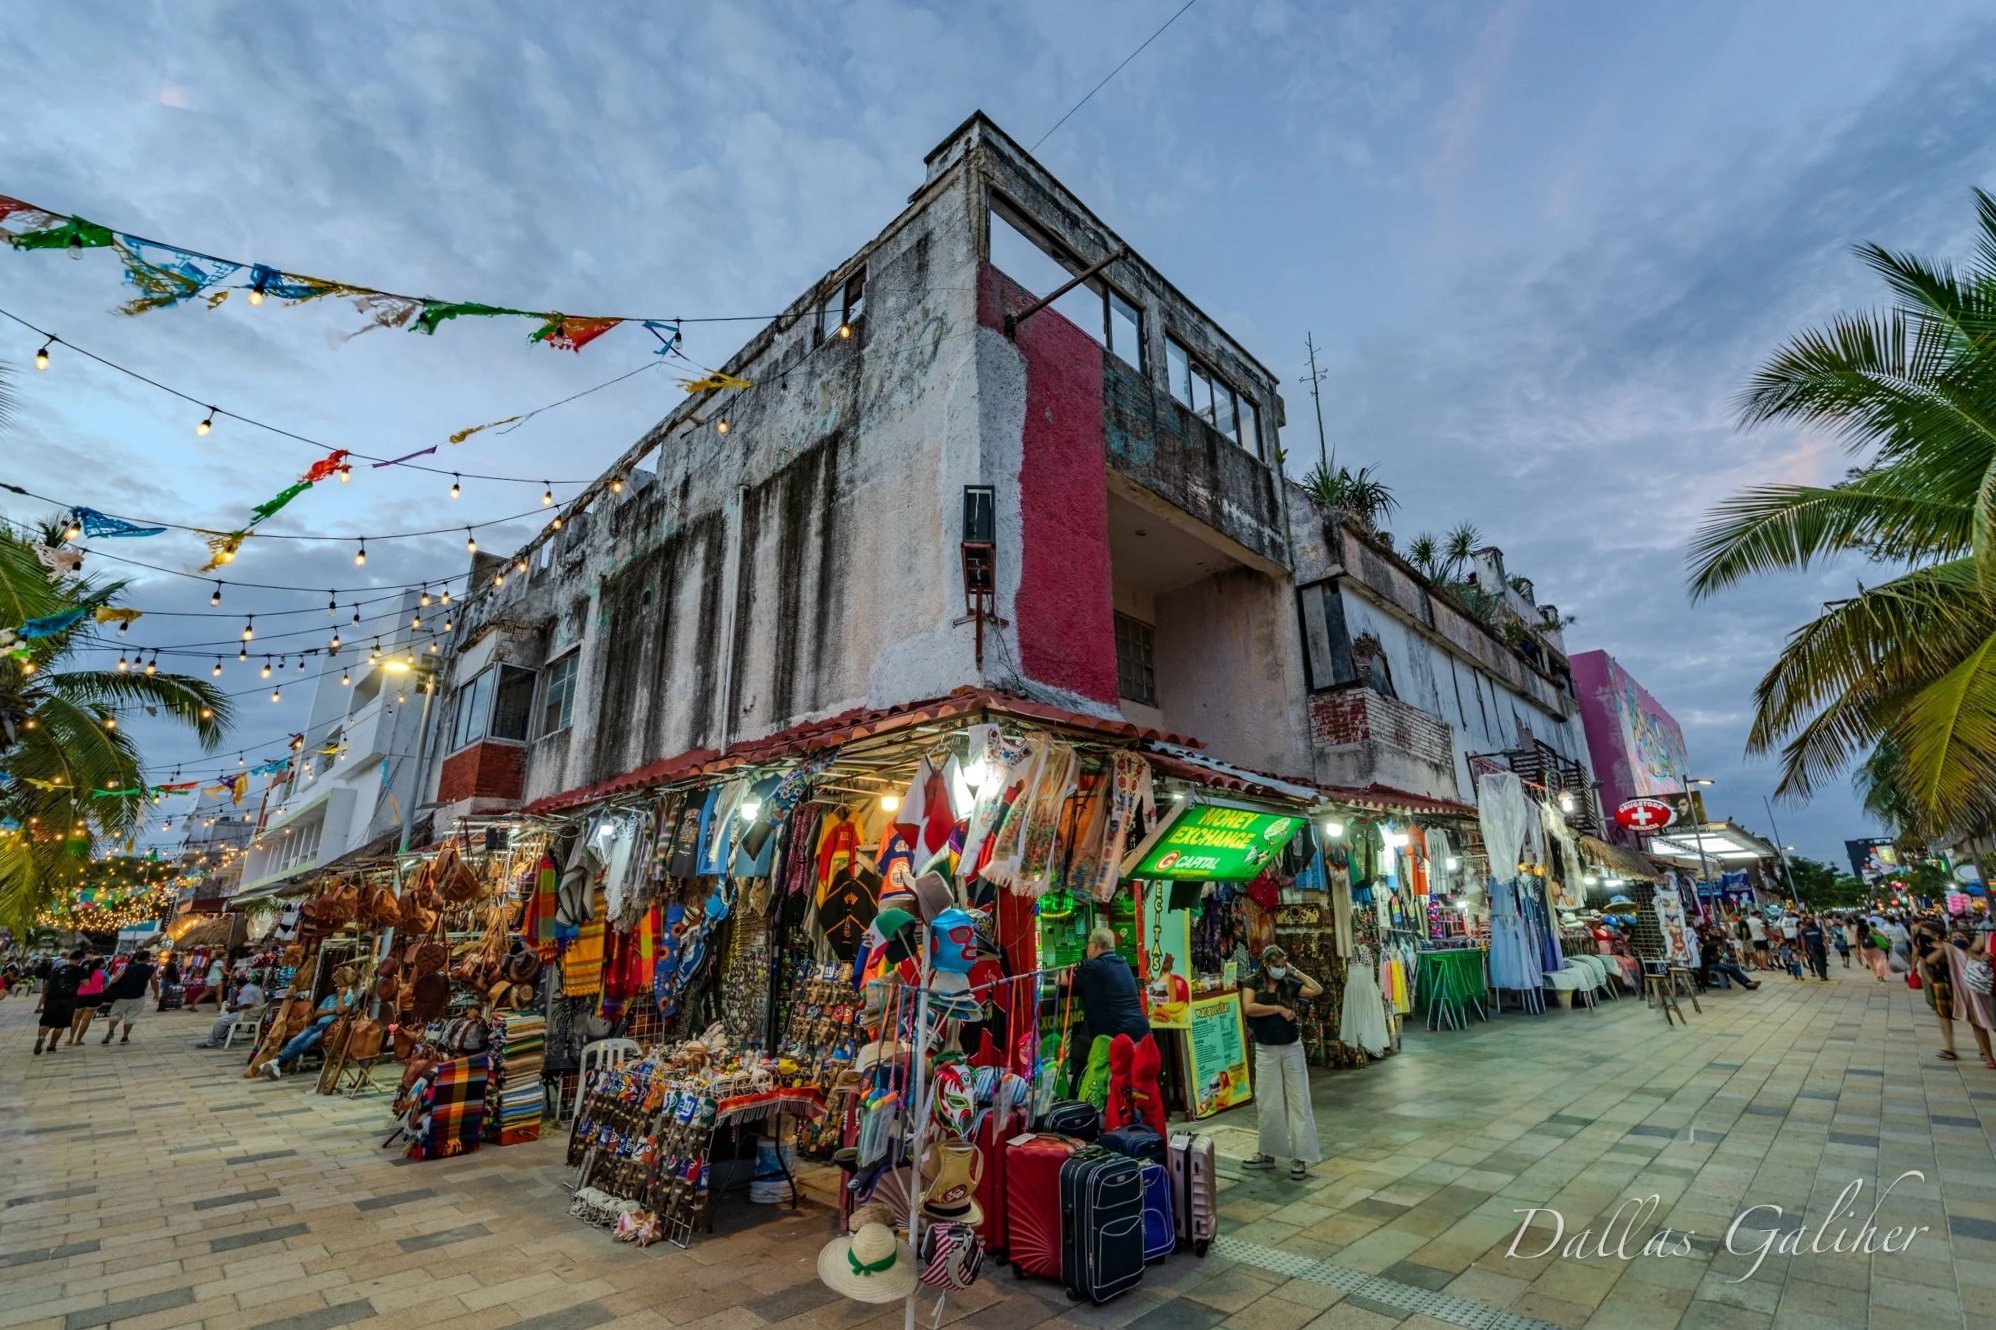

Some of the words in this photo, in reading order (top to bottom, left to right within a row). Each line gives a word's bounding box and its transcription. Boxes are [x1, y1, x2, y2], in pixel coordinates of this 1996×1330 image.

[1618, 800, 1664, 814] DRUGSTORE
[1197, 807, 1260, 830] MONEY
[1628, 822, 1660, 830] FARMACIA
[1168, 826, 1257, 849] EXCHANGE
[1176, 855, 1222, 870] CAPITAL
[1151, 879, 1163, 971] ECITAS
